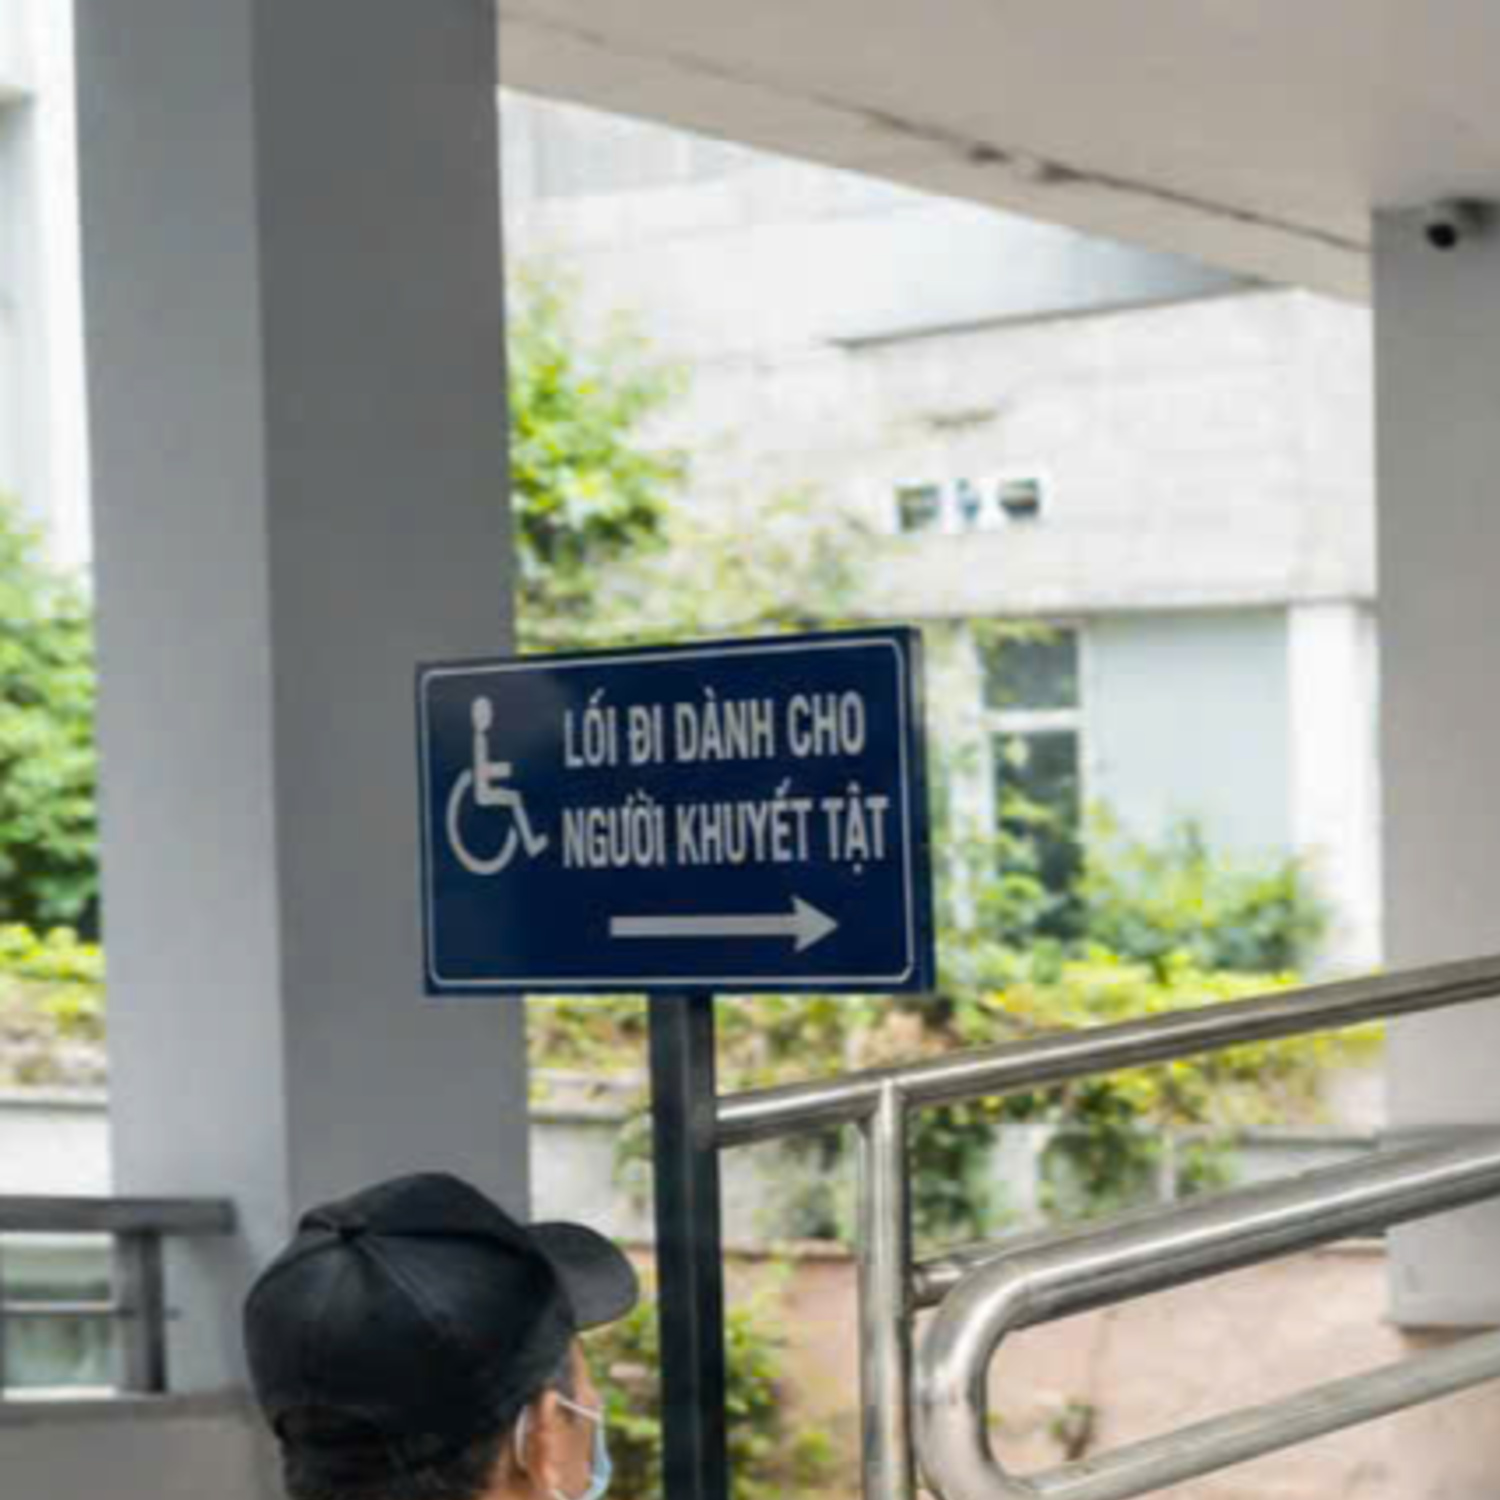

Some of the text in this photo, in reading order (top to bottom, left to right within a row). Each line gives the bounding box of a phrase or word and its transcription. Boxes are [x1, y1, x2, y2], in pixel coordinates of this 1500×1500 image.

[563, 686, 867, 768] LỐI ĐI DÀNH CHO
[562, 776, 889, 873] NGƯỜI KHUYẾT TẬT
